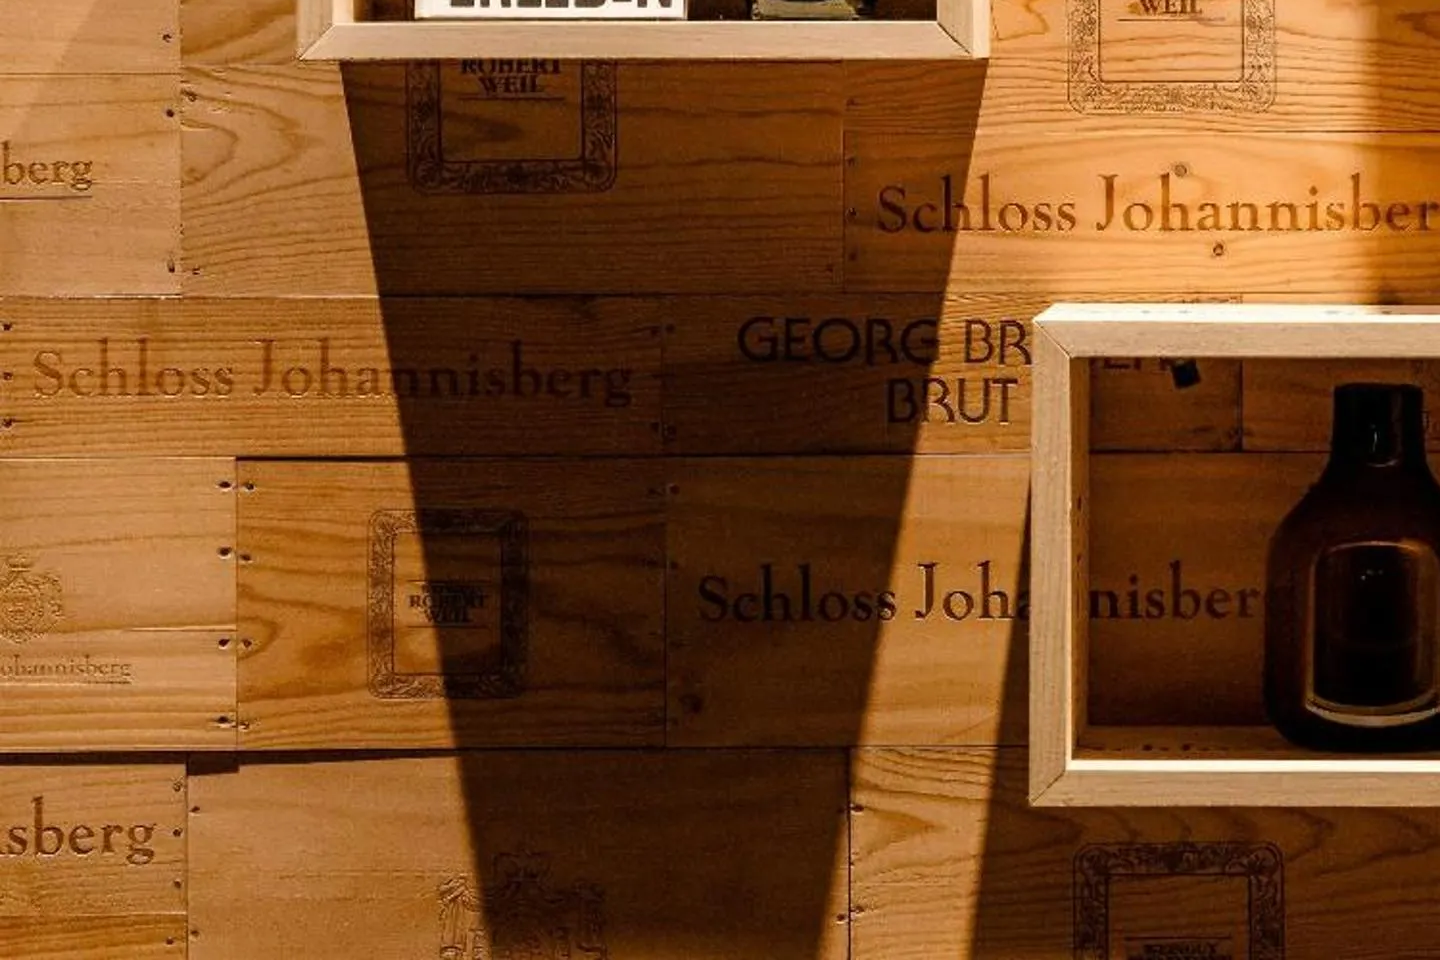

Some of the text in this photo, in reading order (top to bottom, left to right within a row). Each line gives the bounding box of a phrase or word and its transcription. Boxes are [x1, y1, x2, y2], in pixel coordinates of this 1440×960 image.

[876, 174, 1077, 234] Schloss
[737, 315, 941, 367] GEORG
[32, 339, 633, 408] Schloss Johannisberg
[886, 377, 1018, 425] BRUT
[698, 561, 896, 623] Schloss
